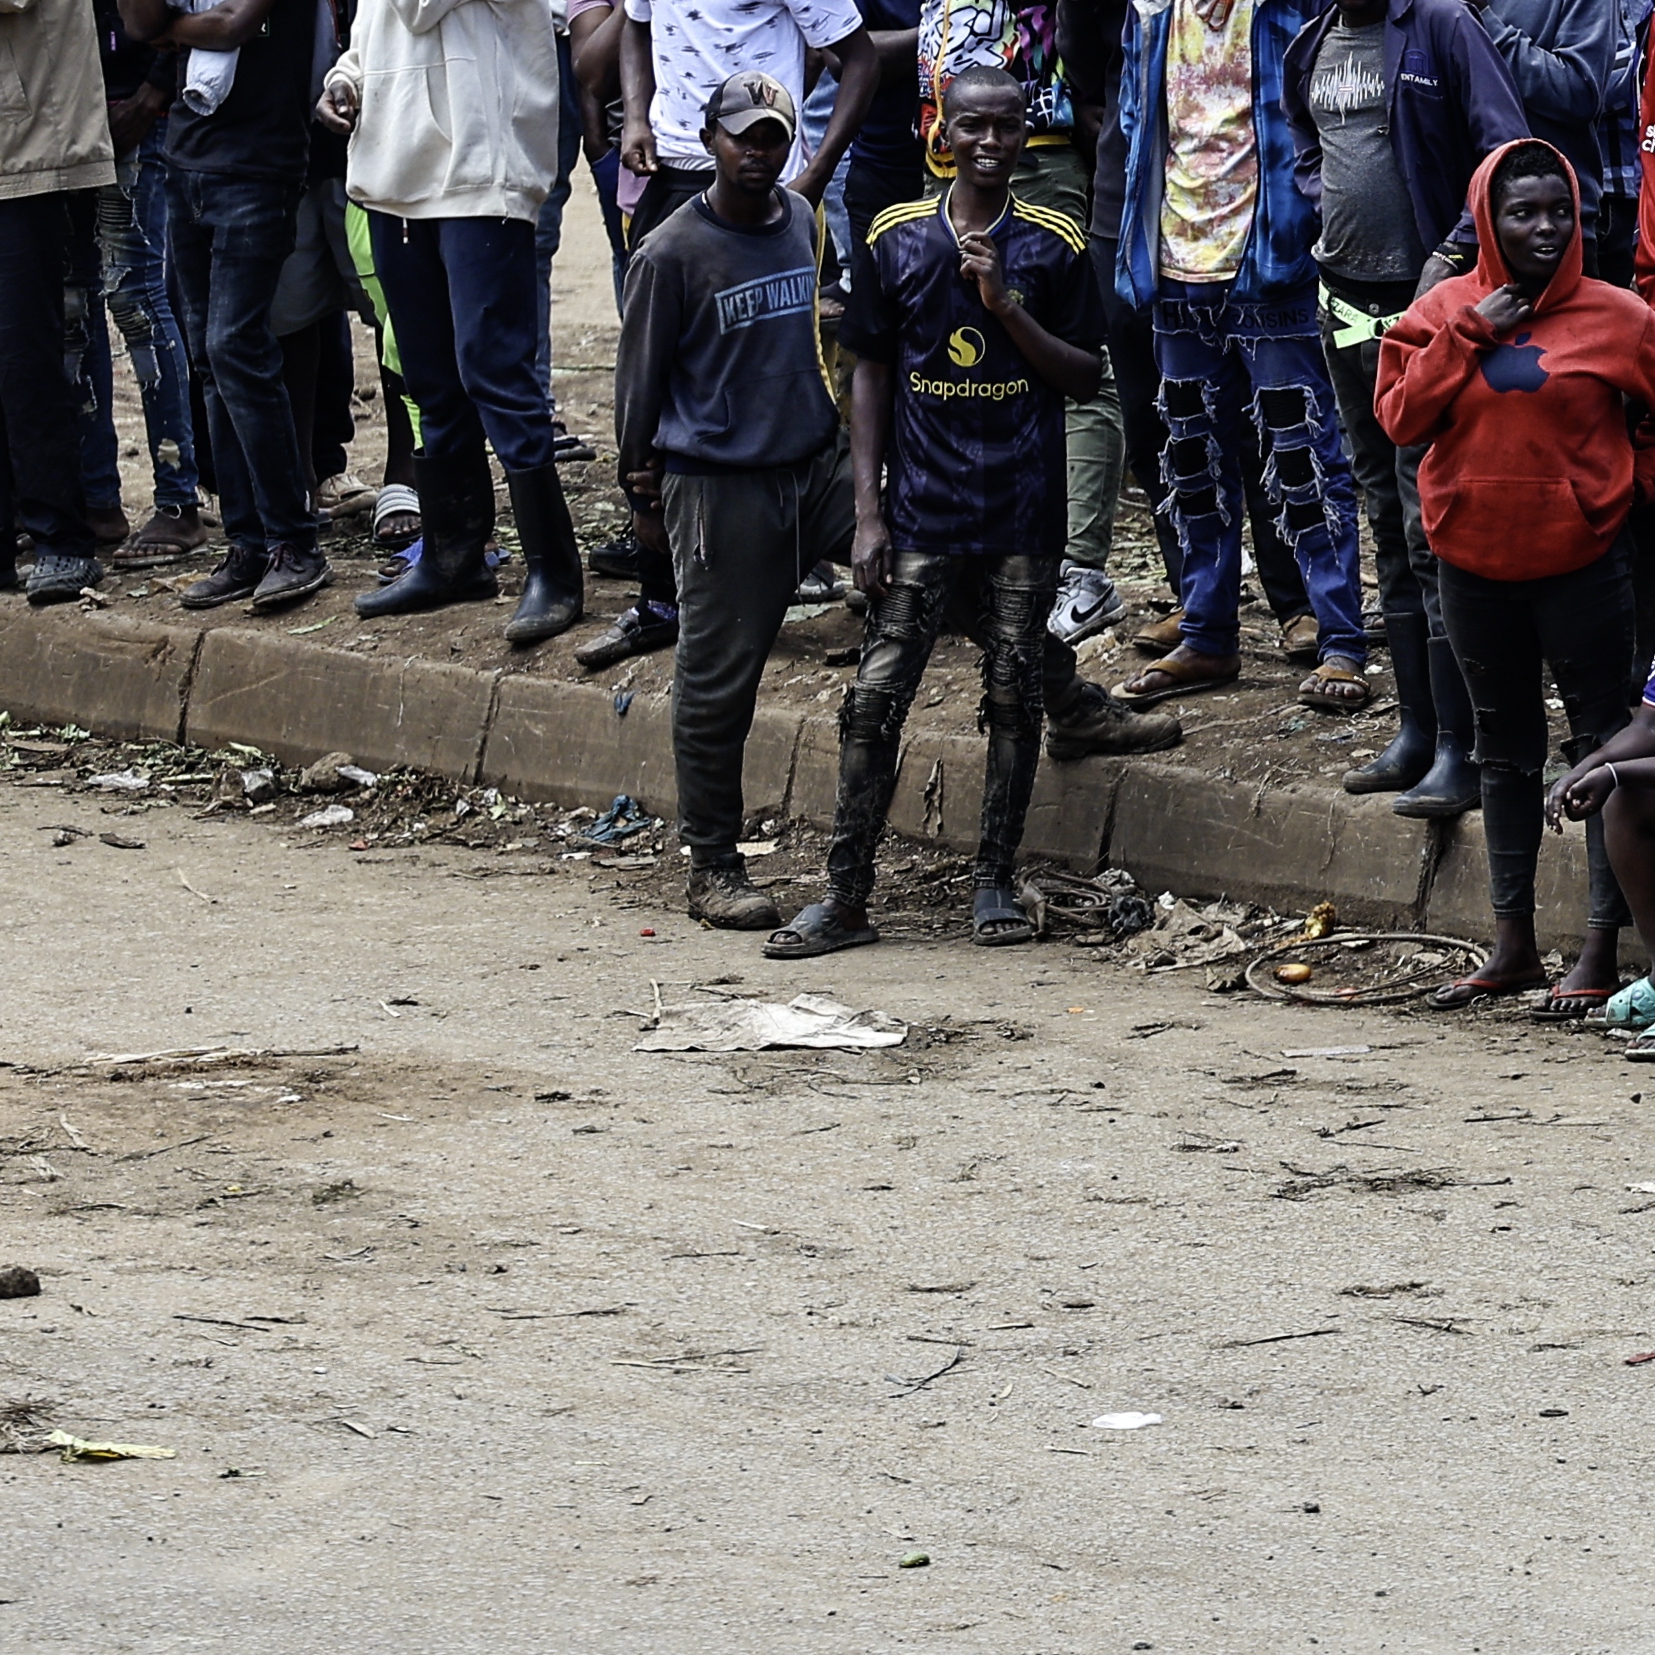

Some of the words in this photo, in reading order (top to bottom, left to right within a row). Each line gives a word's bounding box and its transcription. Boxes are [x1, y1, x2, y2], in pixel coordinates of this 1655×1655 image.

[743, 79, 779, 107] W
[723, 286, 763, 325] KEEP
[909, 371, 1029, 401] Snapdragon
